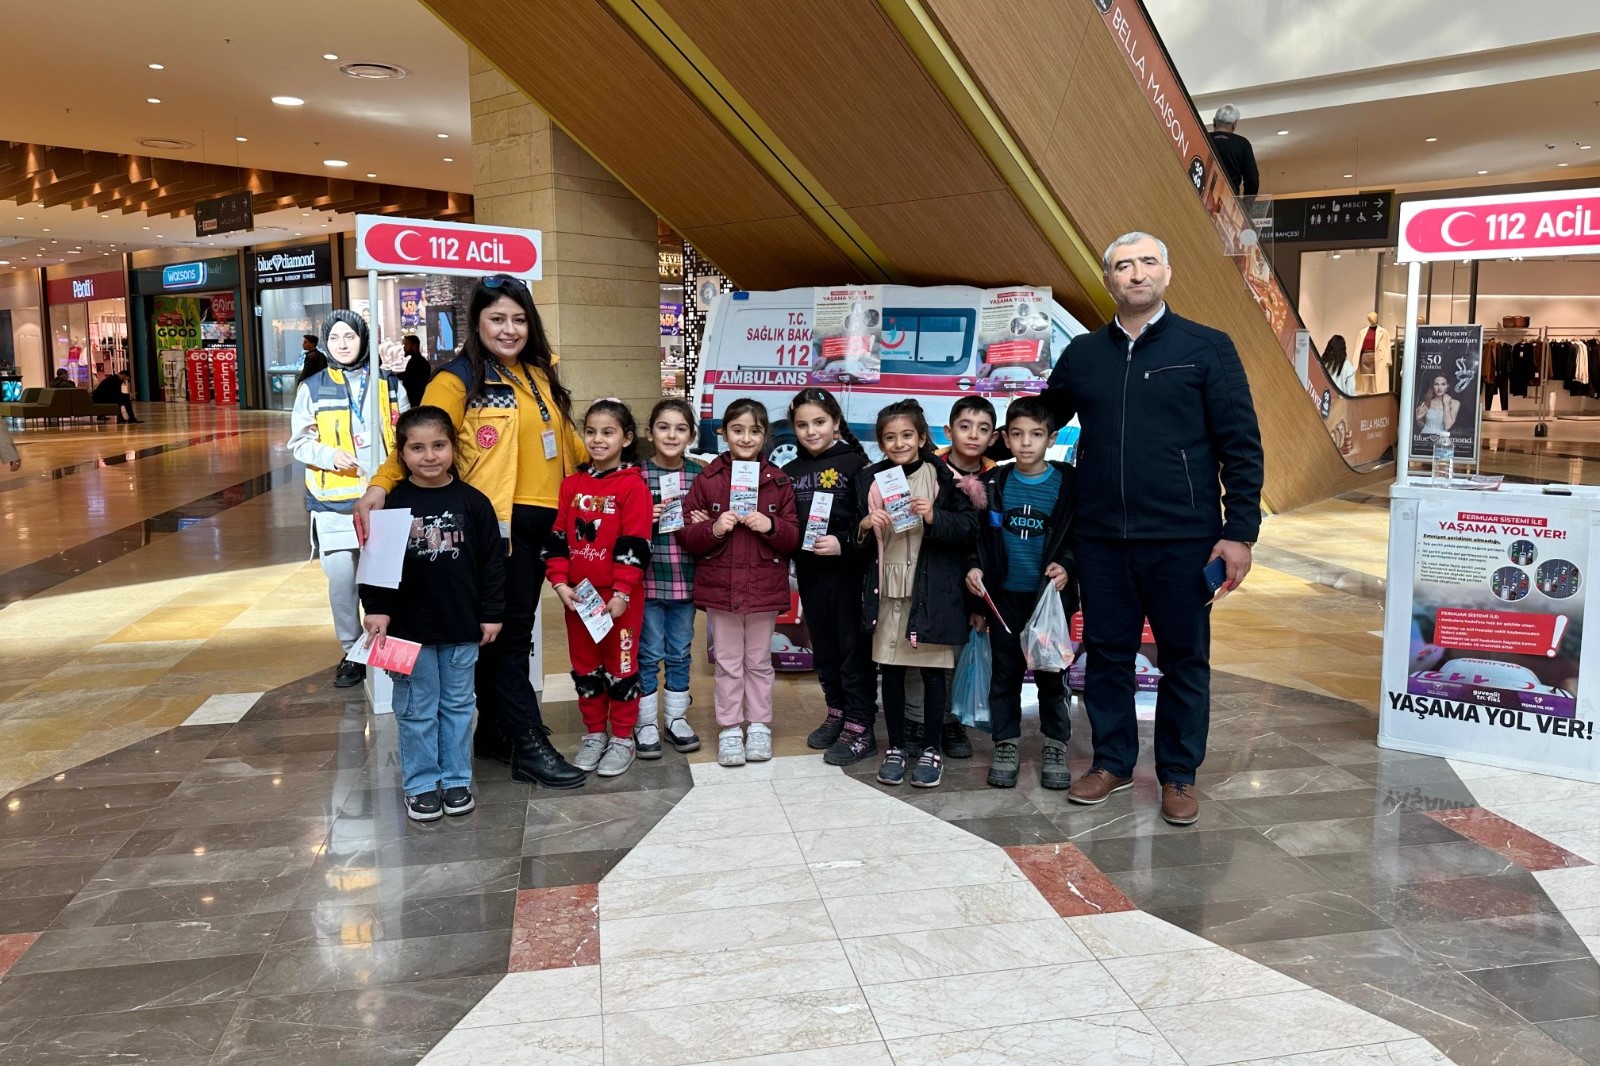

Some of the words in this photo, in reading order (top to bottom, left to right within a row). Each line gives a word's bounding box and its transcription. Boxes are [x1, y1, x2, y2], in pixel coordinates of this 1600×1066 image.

[1112, 7, 1145, 79] BELLA
[1147, 72, 1189, 158] MAISON
[1485, 212, 1526, 241] 112
[1534, 205, 1600, 239] ACİL
[428, 236, 459, 261] 112
[466, 238, 511, 265] ACİL
[257, 256, 273, 271] blue
[282, 250, 315, 269] diamond
[167, 270, 196, 282] watsons
[788, 312, 807, 325] T.C.
[157, 328, 197, 338] GOOD
[747, 326, 784, 341] SAĞLIK
[191, 352, 208, 361] 60
[216, 352, 234, 361] 60
[776, 344, 810, 366] 112
[719, 371, 808, 385] AMBULANS
[1009, 516, 1044, 529] XBOX
[1461, 514, 1499, 523] FERMUAR
[1500, 516, 1531, 525] SİSTEMİ
[1531, 518, 1543, 526] İLE
[1439, 521, 1497, 534] YAŞAMA
[1501, 526, 1529, 537] YOL
[1533, 528, 1567, 540] VER!
[1388, 691, 1480, 723] YAŞAMA
[1485, 706, 1531, 732] YOL
[1536, 714, 1594, 741] VER!
